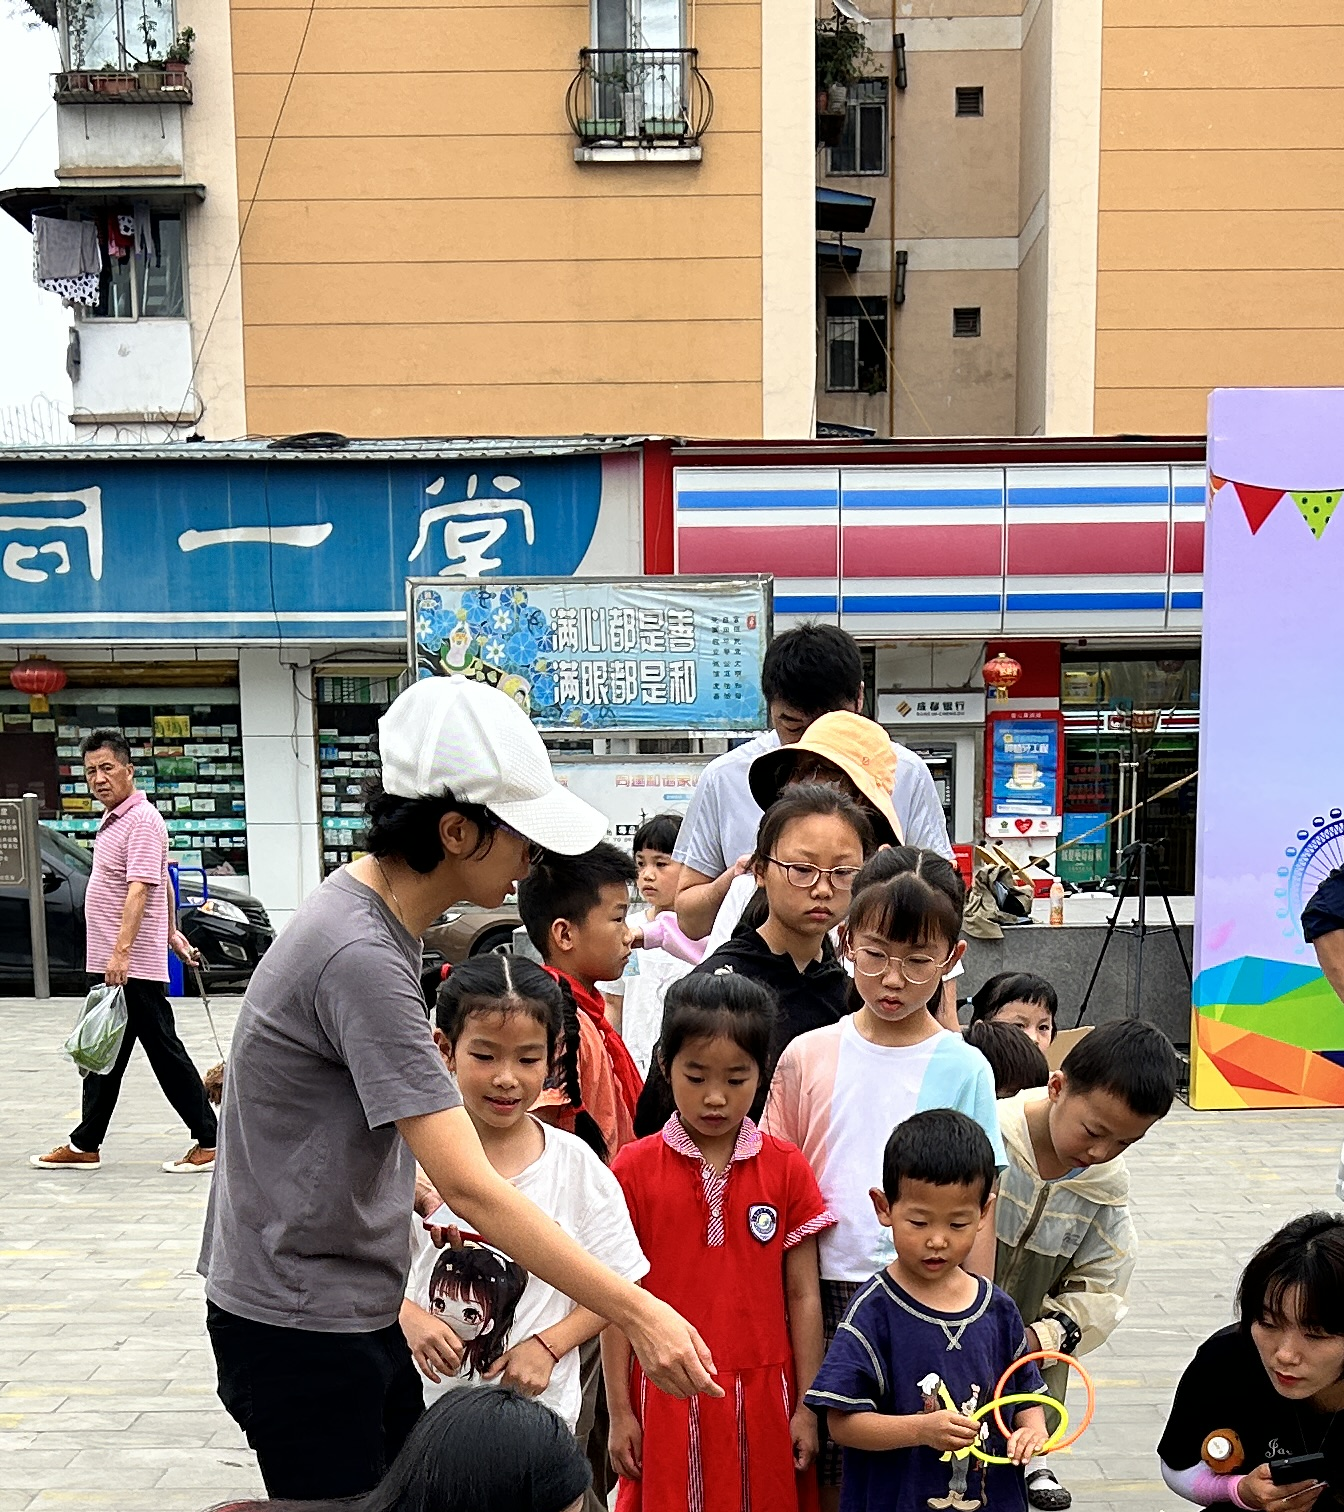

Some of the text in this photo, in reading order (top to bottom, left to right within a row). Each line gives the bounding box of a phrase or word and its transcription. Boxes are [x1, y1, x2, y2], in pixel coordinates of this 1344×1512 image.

[550, 607, 696, 653] 满心都是善
[552, 660, 697, 705] 满眼都是和
[916, 700, 966, 711] 成都银行
